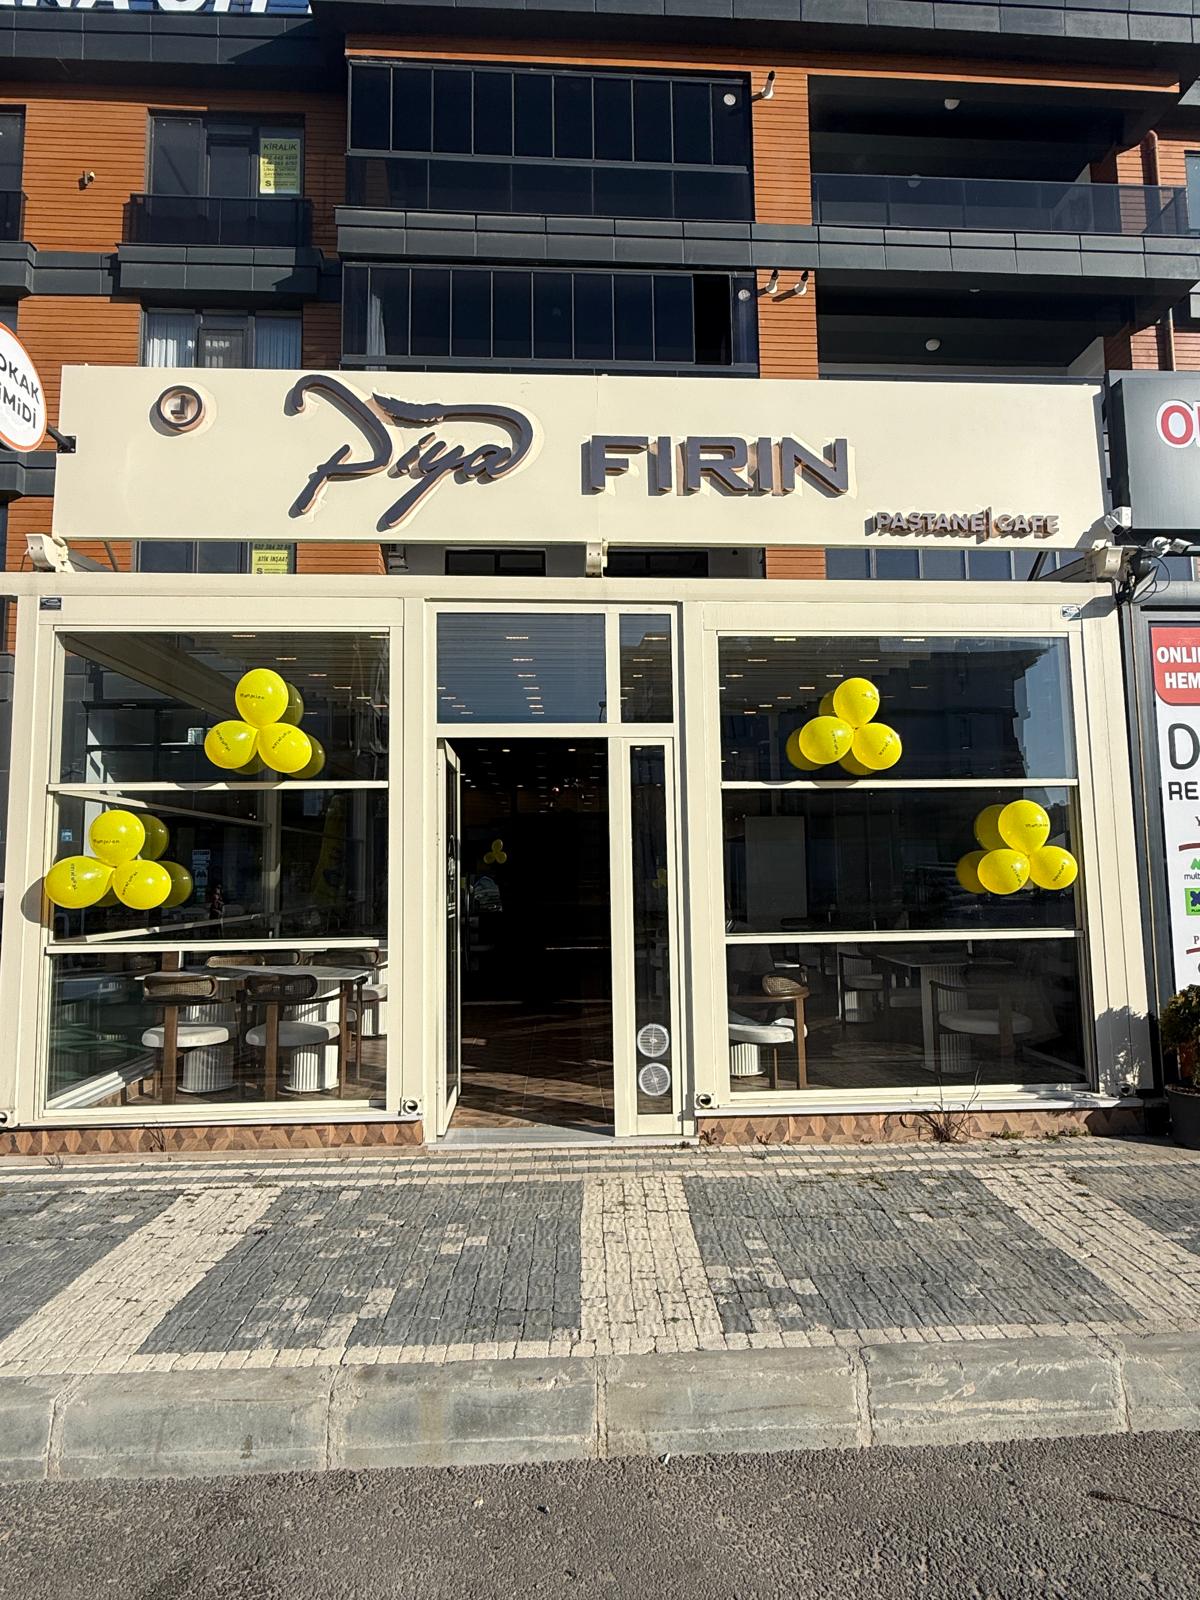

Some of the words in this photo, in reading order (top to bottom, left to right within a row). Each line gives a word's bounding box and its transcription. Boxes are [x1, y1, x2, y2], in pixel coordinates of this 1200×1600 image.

[263, 142, 297, 151] KİRALIK
[1157, 400, 1200, 448] O
[581, 435, 849, 496] FIRIN
[867, 512, 985, 538] PASTANE
[997, 514, 1060, 538] CAFE
[1156, 646, 1200, 664] ONLI
[1168, 781, 1199, 801] RE
